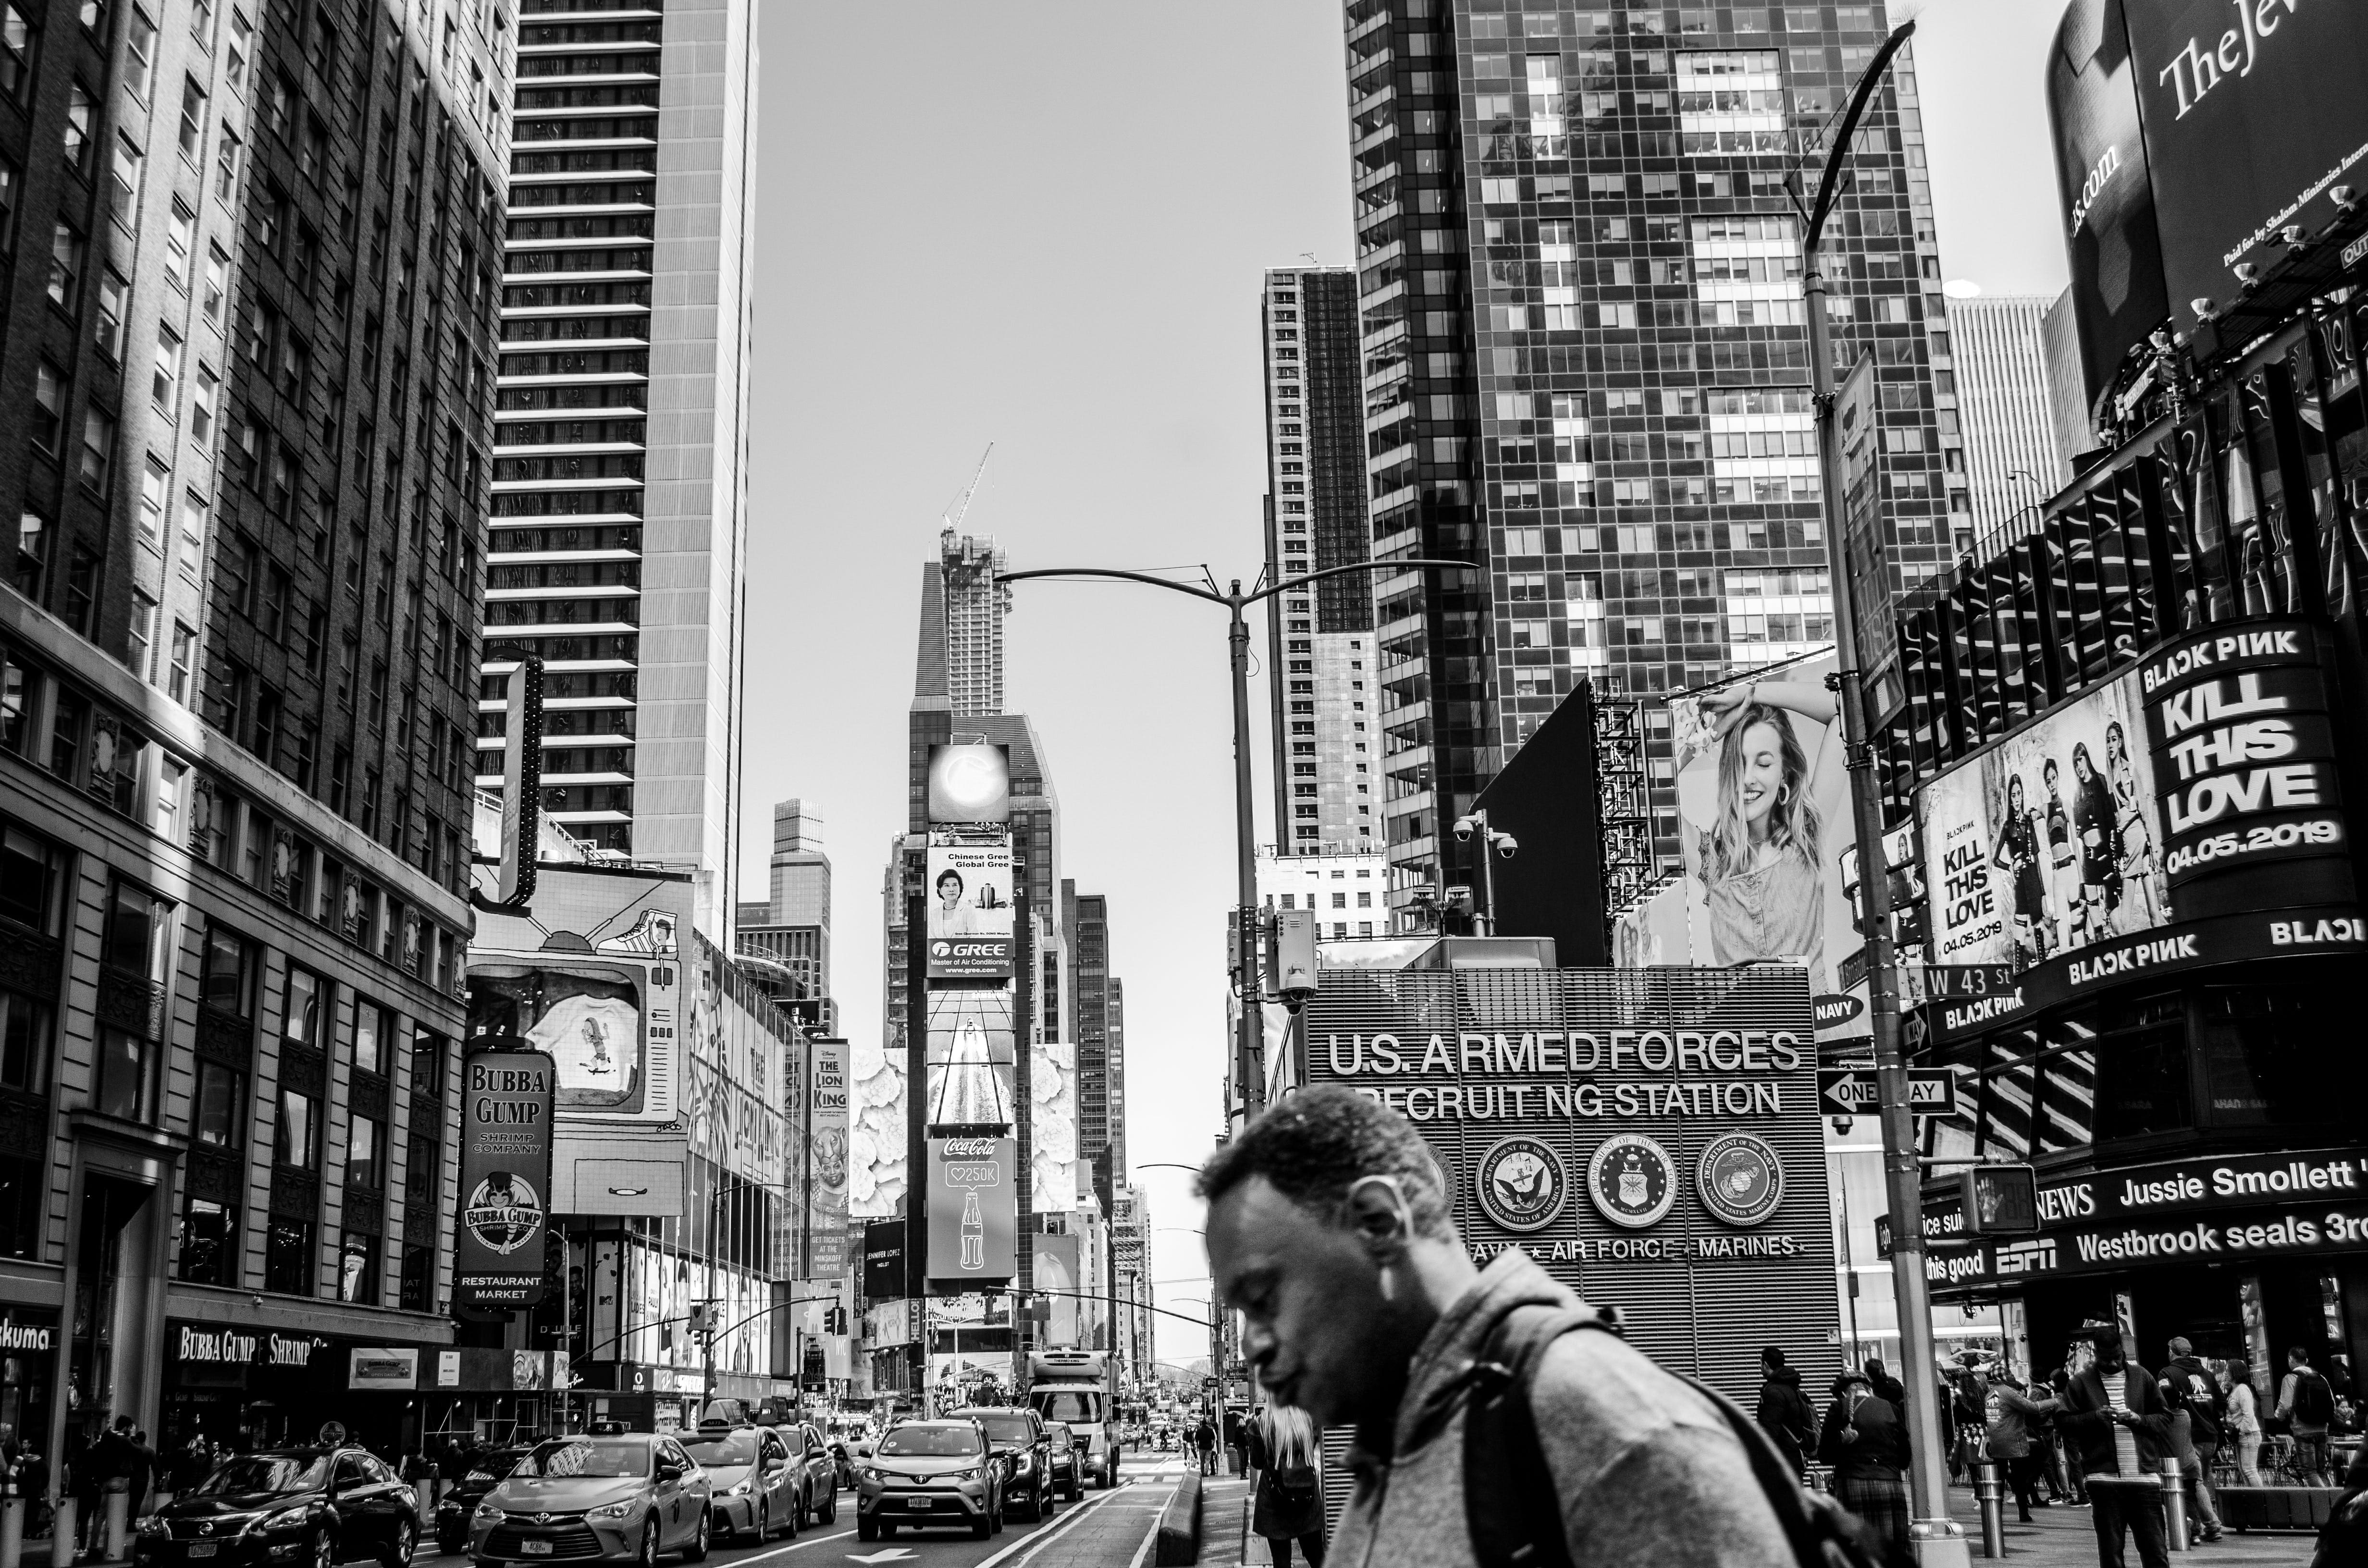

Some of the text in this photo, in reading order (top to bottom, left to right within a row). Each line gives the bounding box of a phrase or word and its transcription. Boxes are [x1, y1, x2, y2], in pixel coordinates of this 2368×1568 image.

[2223, 244, 2242, 267] Paid
[2242, 236, 2255, 252] for
[2255, 227, 2266, 241] by
[2266, 208, 2298, 233] Shalom
[2297, 166, 2341, 208] Ministries
[2162, 673, 2287, 738] KILL
[2169, 720, 2296, 781] THIS
[2167, 764, 2320, 834] LOVE
[1943, 839, 1985, 876] KILL
[2167, 821, 2341, 875] 04.05.2019
[1944, 865, 1987, 901] THIS
[1945, 889, 1994, 930] LOVE
[953, 944, 1007, 956] GREE
[1944, 920, 2002, 955] 04.05.2019
[1929, 968, 2011, 995] W 43 St
[1815, 1000, 1853, 1020] NAVY
[1908, 1018, 1923, 1042] WAY
[819, 1061, 839, 1070] THE
[1329, 1030, 1801, 1075] U.S. ARMED FORCES
[470, 1064, 547, 1093] BUBBA
[816, 1072, 843, 1089] LION
[1910, 1083, 1936, 1101] AY
[475, 1097, 542, 1125] GUMP
[814, 1090, 846, 1109] KING
[1615, 1082, 1781, 1116] STATION
[472, 1144, 542, 1154] COMPANY
[480, 1133, 534, 1142] SHRIMP
[943, 1137, 999, 1155] Coca-Cola
[1485, 1144, 1517, 1182] DEPARTMENT
[1532, 1146, 1546, 1158] THE
[1545, 1155, 1559, 1175] NAVY
[1591, 1136, 1675, 1198] DEPARTMENT OF THE AIR FORCE
[1704, 1139, 1738, 1179] DEPARTMENT
[1748, 1141, 1761, 1152] THE
[1760, 1150, 1776, 1171] NAVY
[966, 1167, 995, 1181] 250K
[1441, 1162, 1454, 1187] ARMY
[2120, 1172, 2204, 1207] Jussie
[2212, 1161, 2356, 1195] Smollett
[1485, 1185, 1561, 1223] UNITED STATES OF AMERICA
[1620, 1206, 1648, 1214] MCMXLVII
[1706, 1178, 1777, 1216] UNITED STATES MARINE CORPS
[467, 1208, 541, 1225] BUBBA GUMP
[1943, 1206, 1963, 1233] sui
[471, 1226, 499, 1250] RESTAURANT
[516, 1228, 534, 1245] MARKET
[1551, 1240, 1586, 1260] AIR
[1598, 1238, 1675, 1259] FORCE
[1698, 1236, 1795, 1257] MARINES
[2075, 1223, 2223, 1262] Westbrook
[2226, 1215, 2319, 1249] seals
[866, 1248, 900, 1261] JENNIFER LOPEZ
[1926, 1238, 2057, 1283] this good ESPN
[462, 1277, 542, 1286] RESTAURANT
[475, 1290, 528, 1299] MARKET
[599, 1295, 613, 1306] MTV
[911, 1299, 920, 1341] HELLO!
[180, 1326, 310, 1366] BUBBA GUMP SHRIMP
[836, 1337, 847, 1356] NYC
